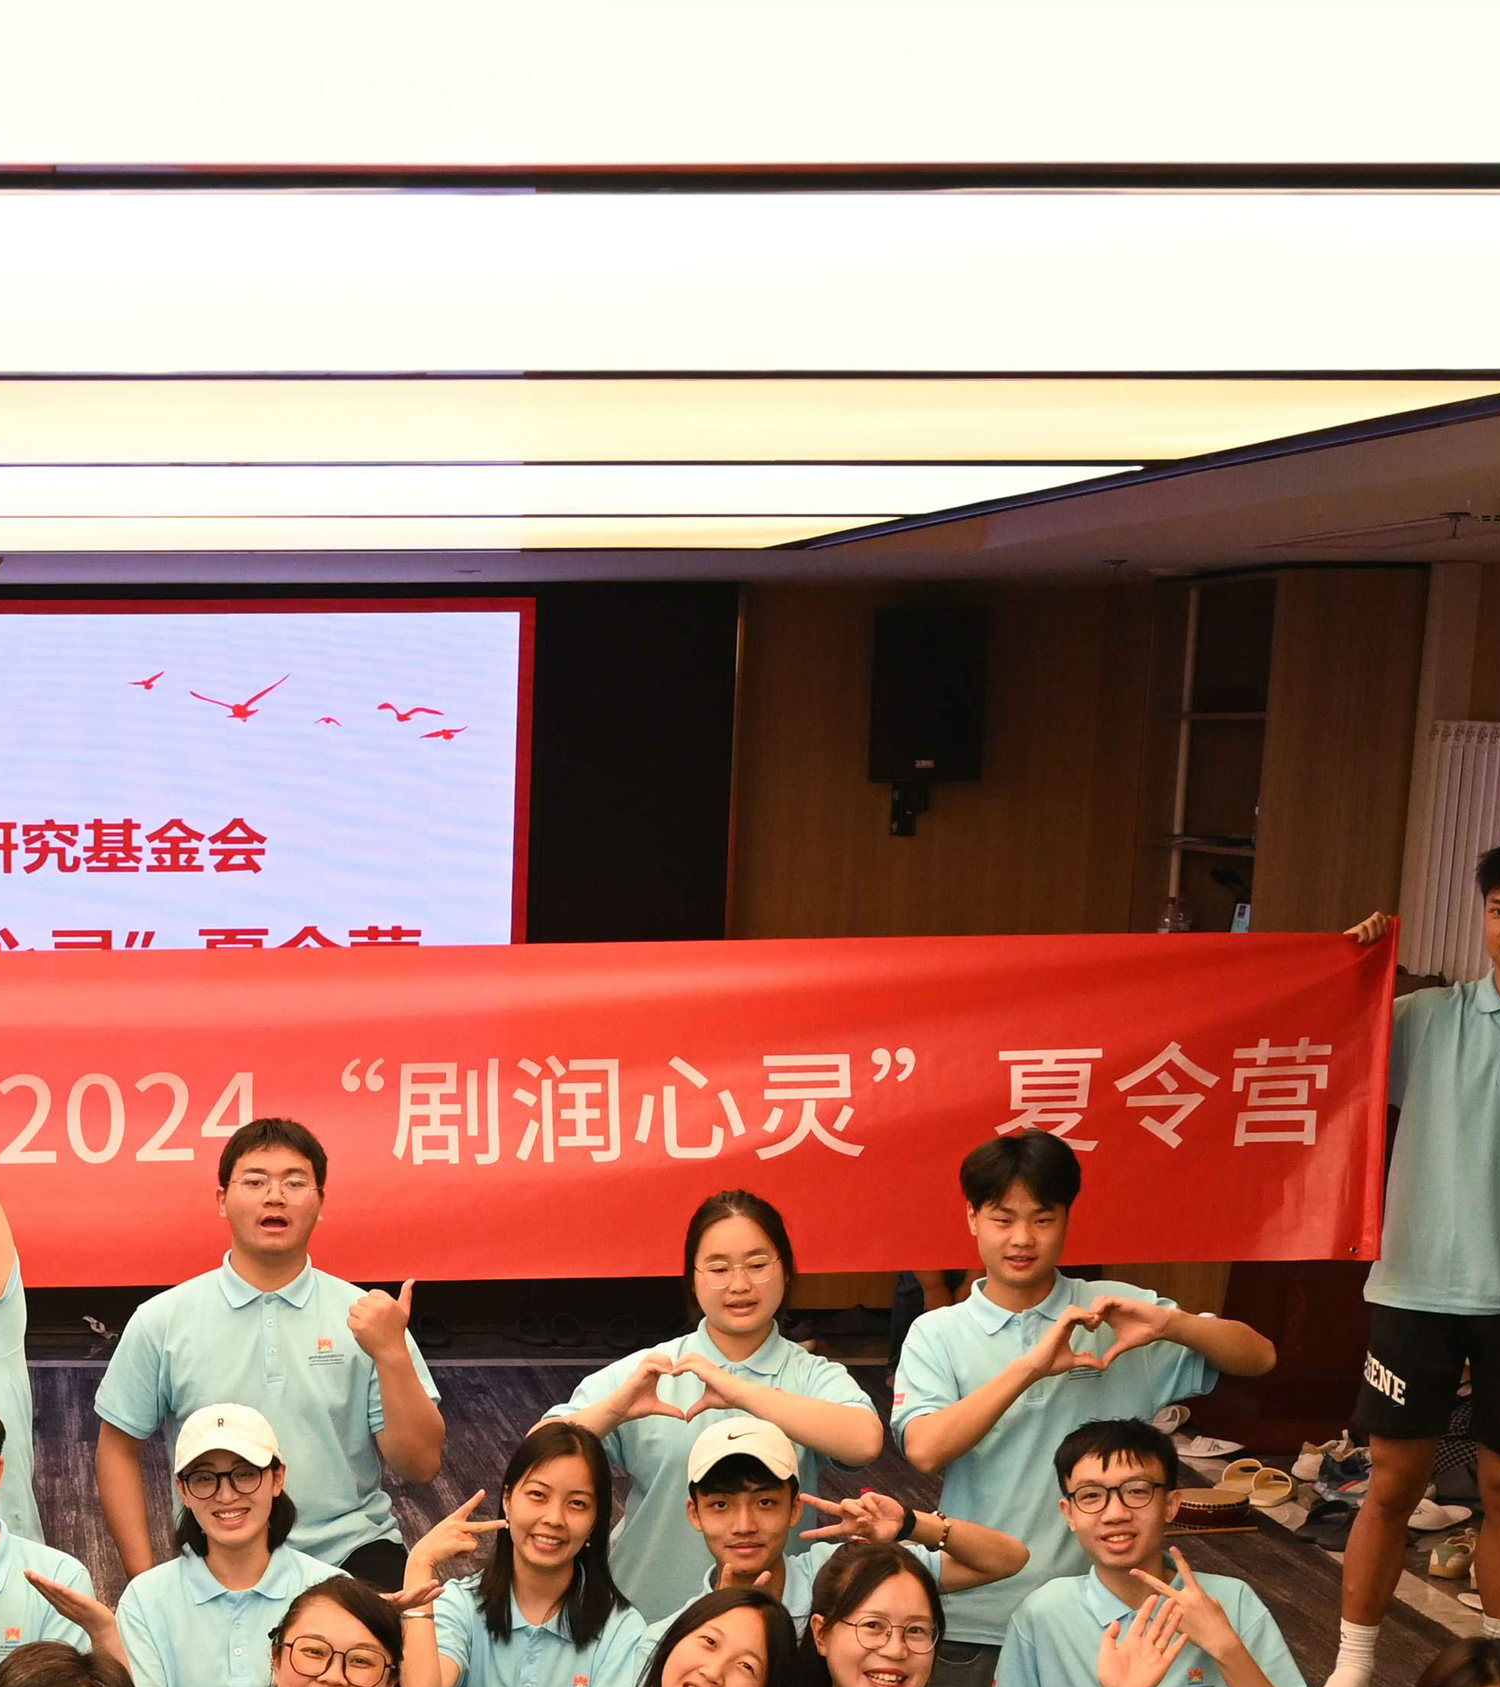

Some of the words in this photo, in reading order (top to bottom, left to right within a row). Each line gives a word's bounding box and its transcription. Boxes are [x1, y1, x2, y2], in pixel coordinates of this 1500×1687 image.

[994, 1037, 1333, 1152] 夏令营
[217, 1417, 225, 1428] R
